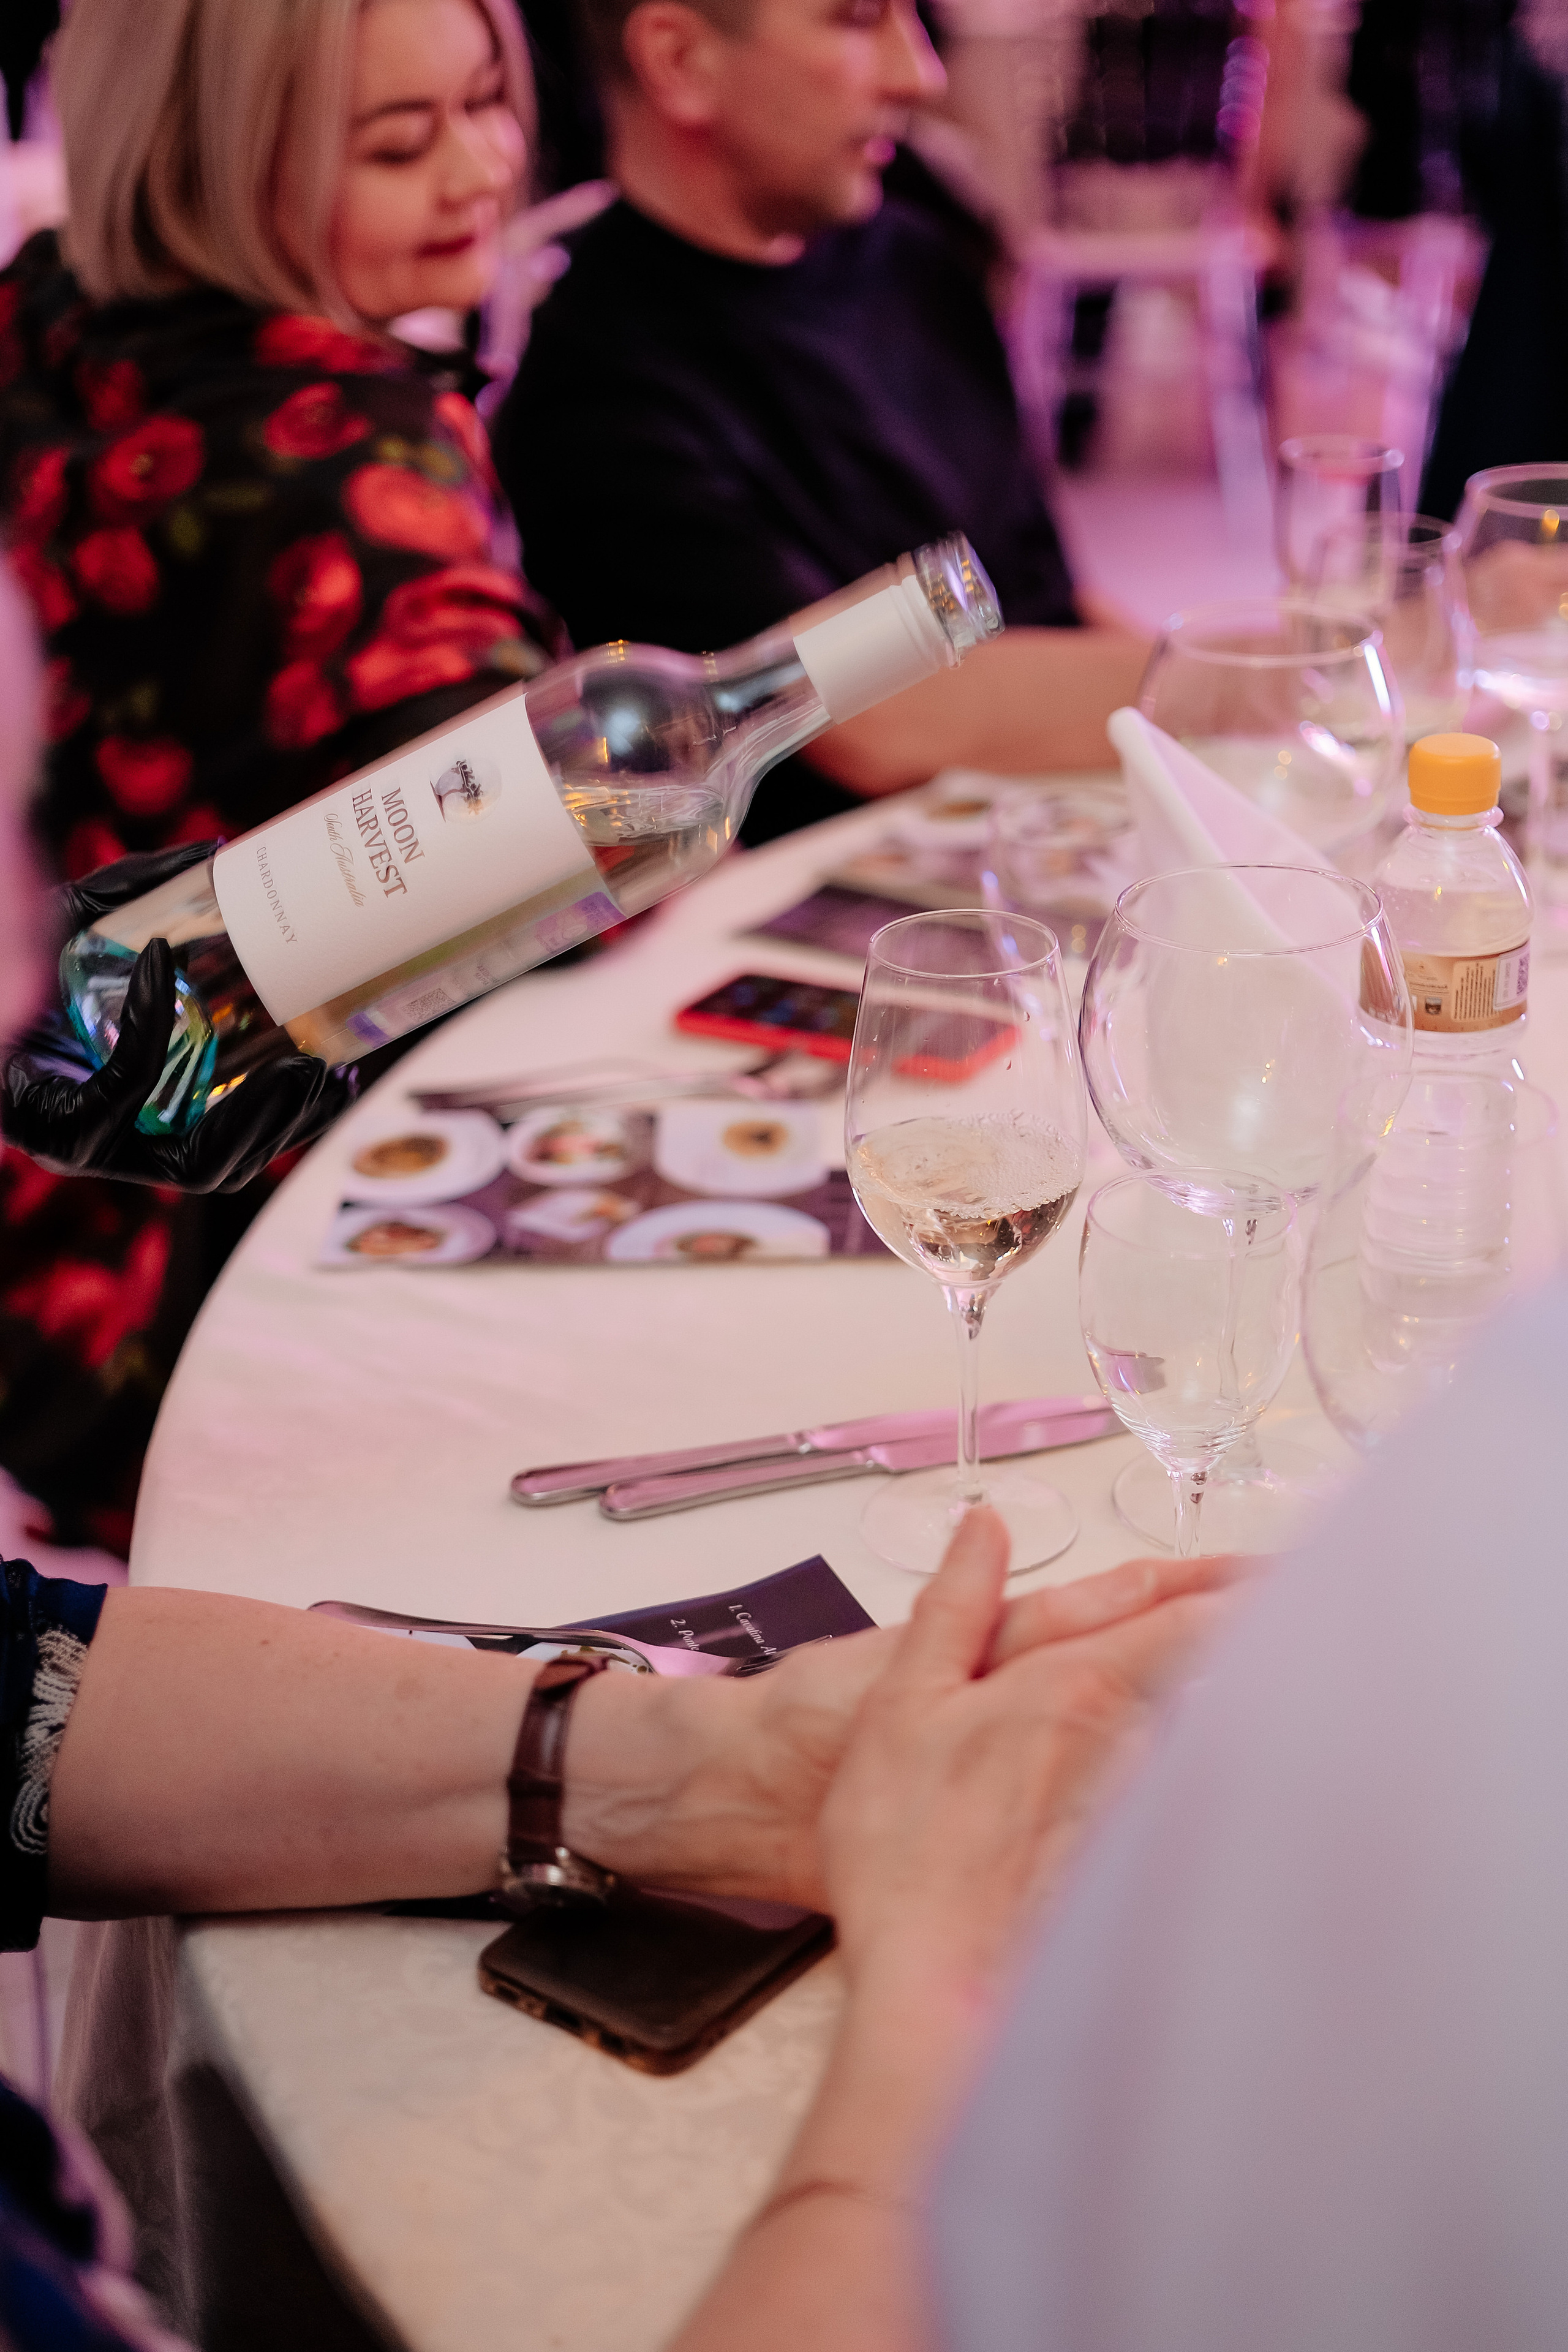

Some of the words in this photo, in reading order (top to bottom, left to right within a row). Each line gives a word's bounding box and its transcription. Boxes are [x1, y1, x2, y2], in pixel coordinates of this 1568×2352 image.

[323, 813, 344, 842] South
[352, 788, 408, 898] HARVEST
[381, 787, 425, 864] MOON
[256, 846, 298, 944] CHARDONNAY
[330, 843, 366, 907] Australia
[670, 1619, 686, 1629] 2.
[728, 1604, 743, 1613] 1.
